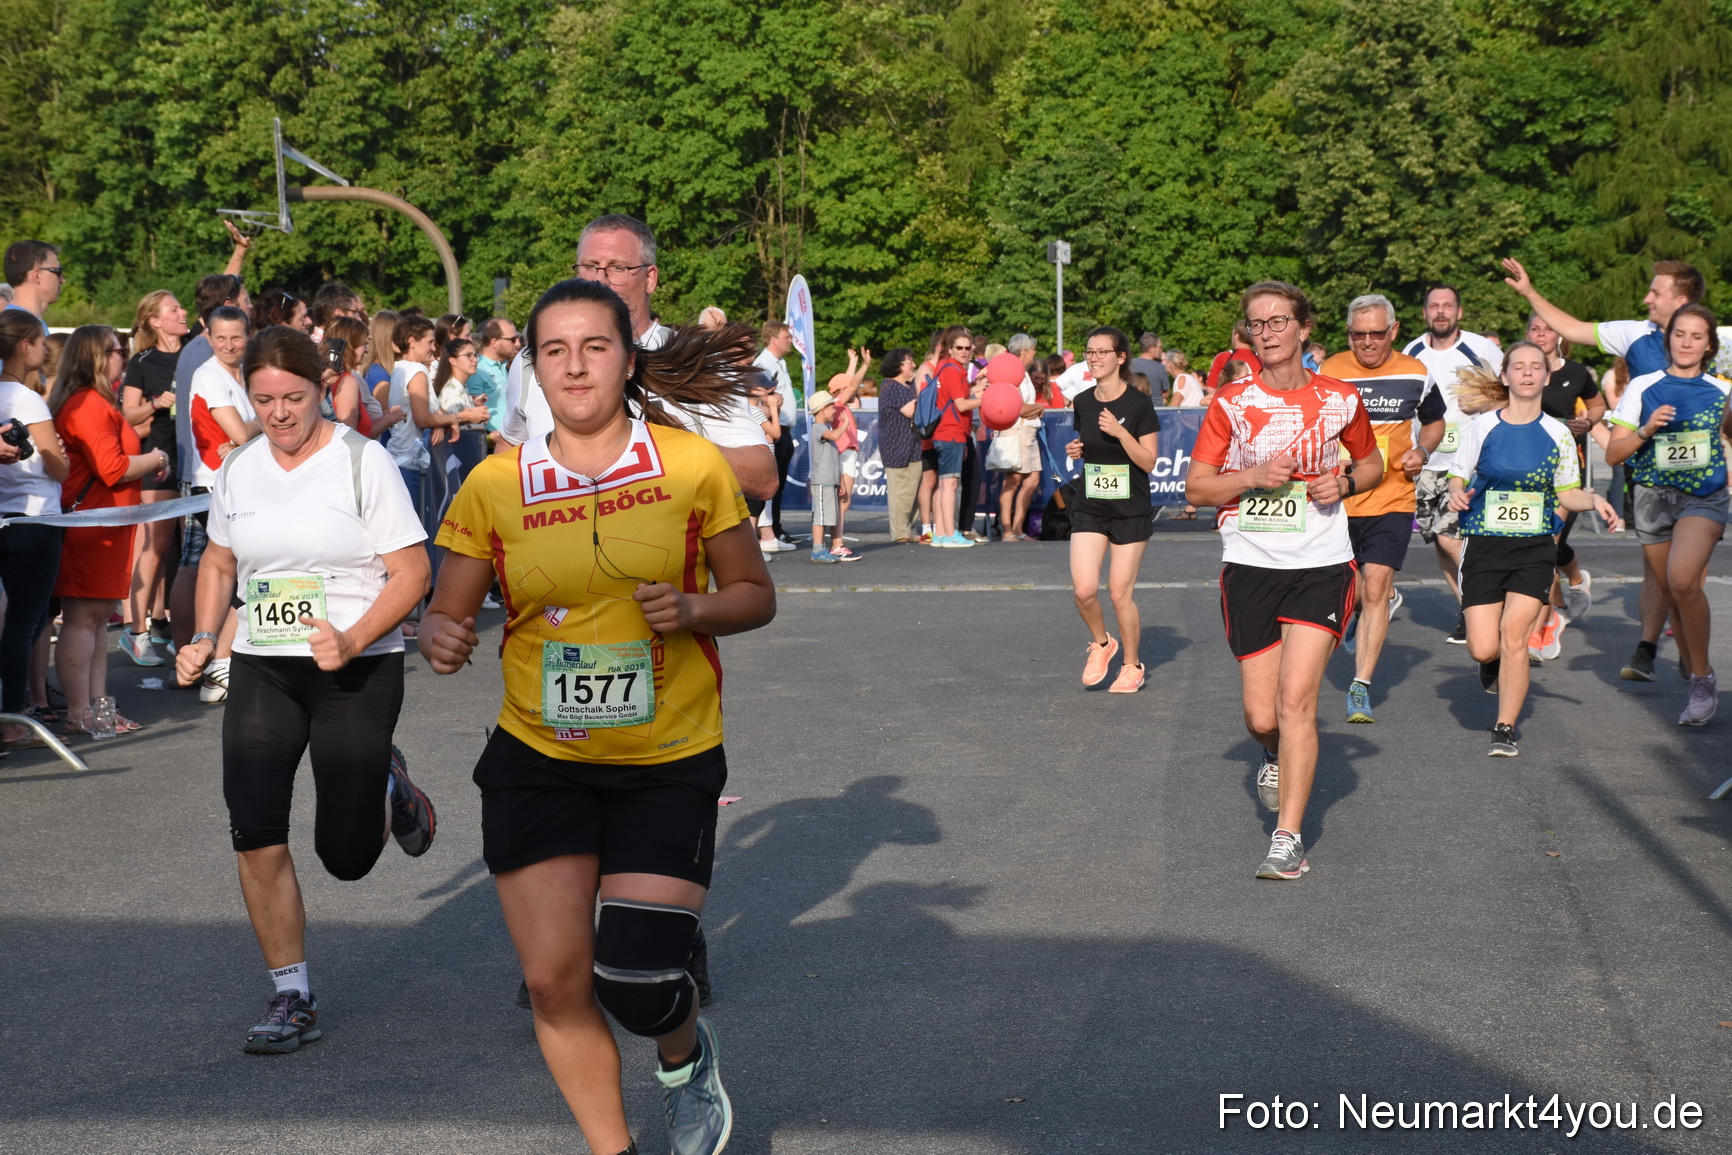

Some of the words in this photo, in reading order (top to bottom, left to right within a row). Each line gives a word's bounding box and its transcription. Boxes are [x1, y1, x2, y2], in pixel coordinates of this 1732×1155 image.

[1668, 445, 1697, 460] 221
[1093, 476, 1119, 490] 434
[523, 504, 588, 531] MAX
[596, 486, 672, 517] BÖGL
[1245, 497, 1297, 517] 2220
[1497, 506, 1530, 521] 265
[254, 600, 314, 626] 1468
[624, 663, 645, 672] 2019
[555, 672, 638, 705] 1577
[557, 704, 603, 714] Gottschalk
[605, 703, 637, 714] Sophie
[569, 713, 584, 721] Bögl
[273, 966, 299, 978] SOCKS
